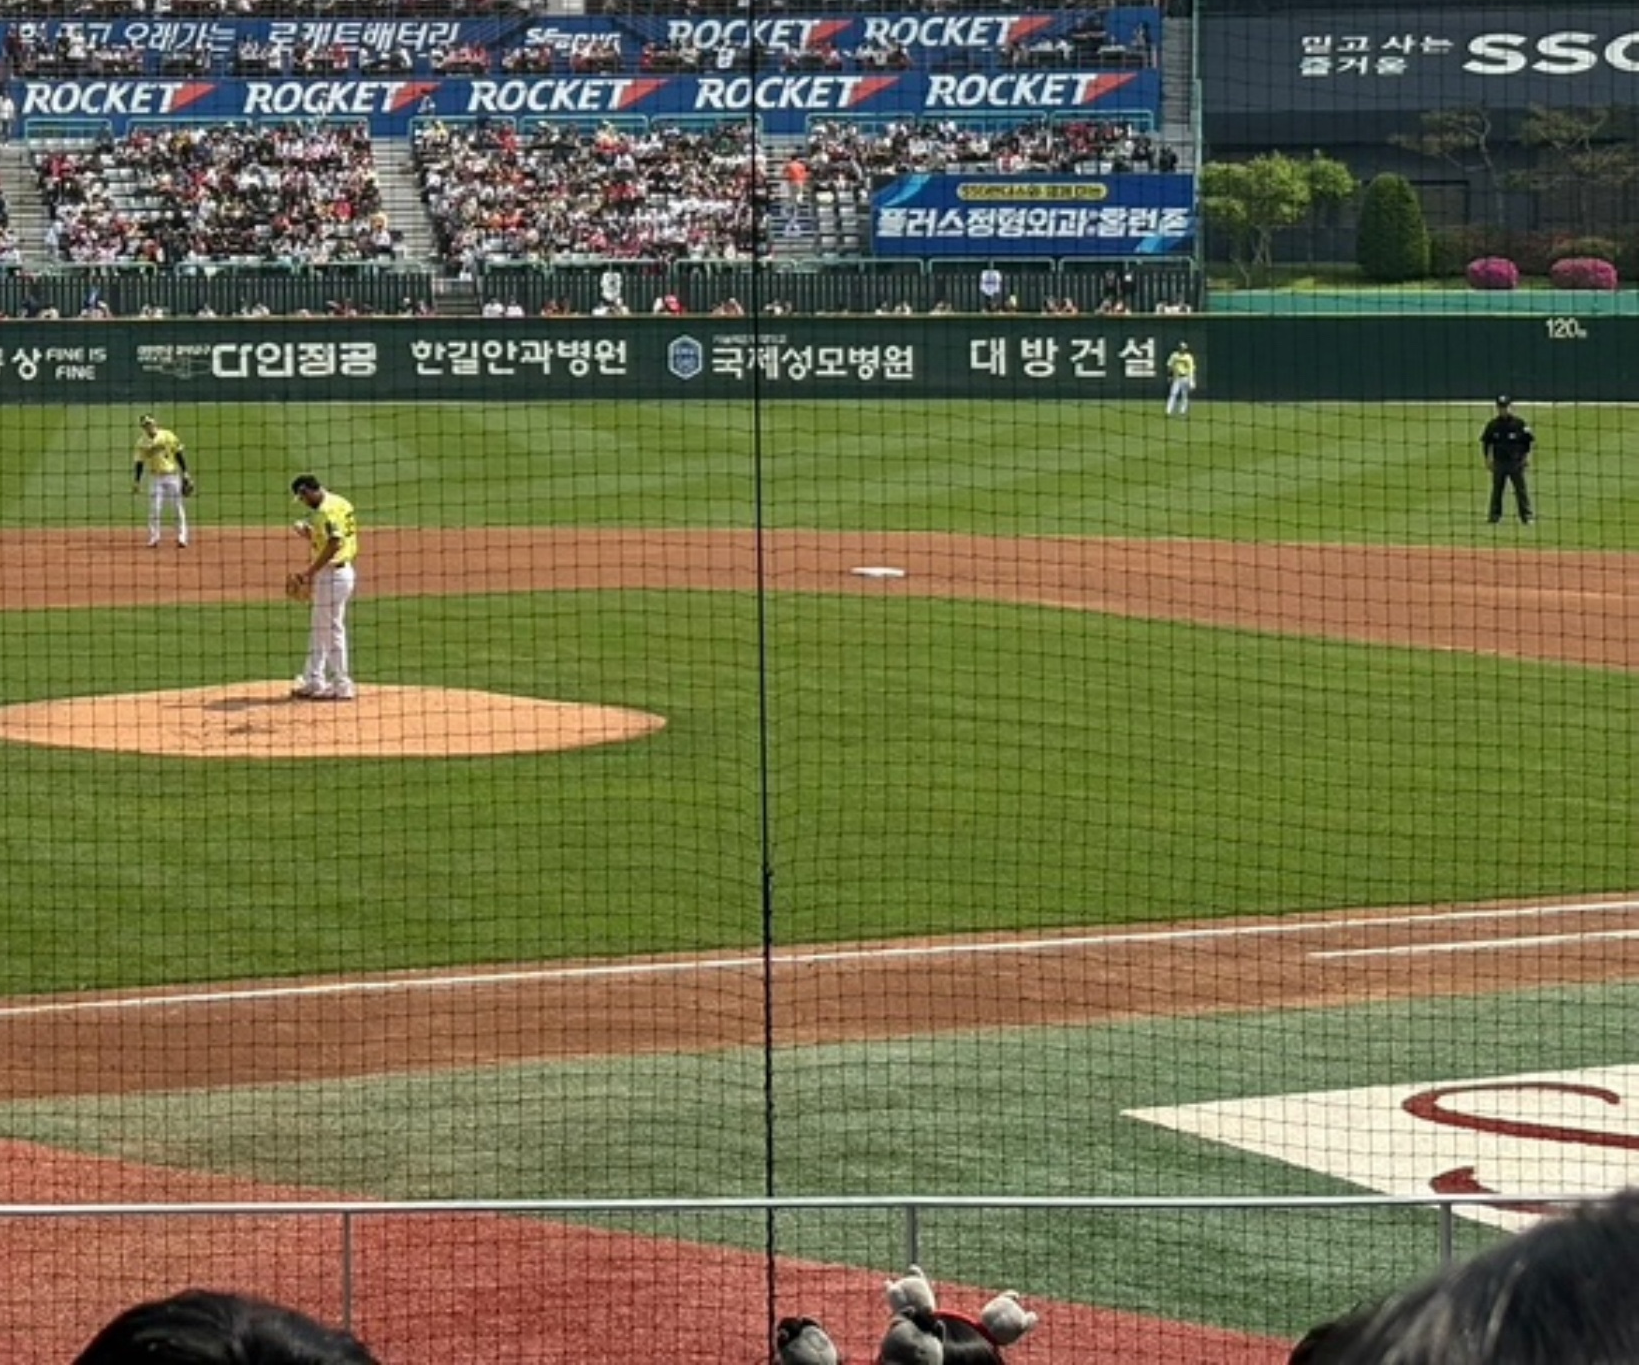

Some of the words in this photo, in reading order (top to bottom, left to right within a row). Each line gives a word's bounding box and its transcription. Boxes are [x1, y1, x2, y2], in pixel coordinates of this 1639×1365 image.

[667, 19, 819, 49] ROCKET
[864, 16, 1020, 46] ROCKET
[1381, 34, 1454, 54] 사는
[23, 82, 183, 114] ROCKET
[244, 82, 409, 114] ROCKET
[467, 78, 633, 111] ROCKET
[694, 77, 862, 109] ROCKET
[925, 74, 1097, 106] ROCKET
[46, 348, 84, 363] FINE
[88, 347, 107, 363] IS
[411, 338, 626, 377] 한길안과병원
[712, 345, 913, 380] 국제성모병원
[969, 337, 1156, 378] 대방건설
[56, 365, 97, 381] FINE
